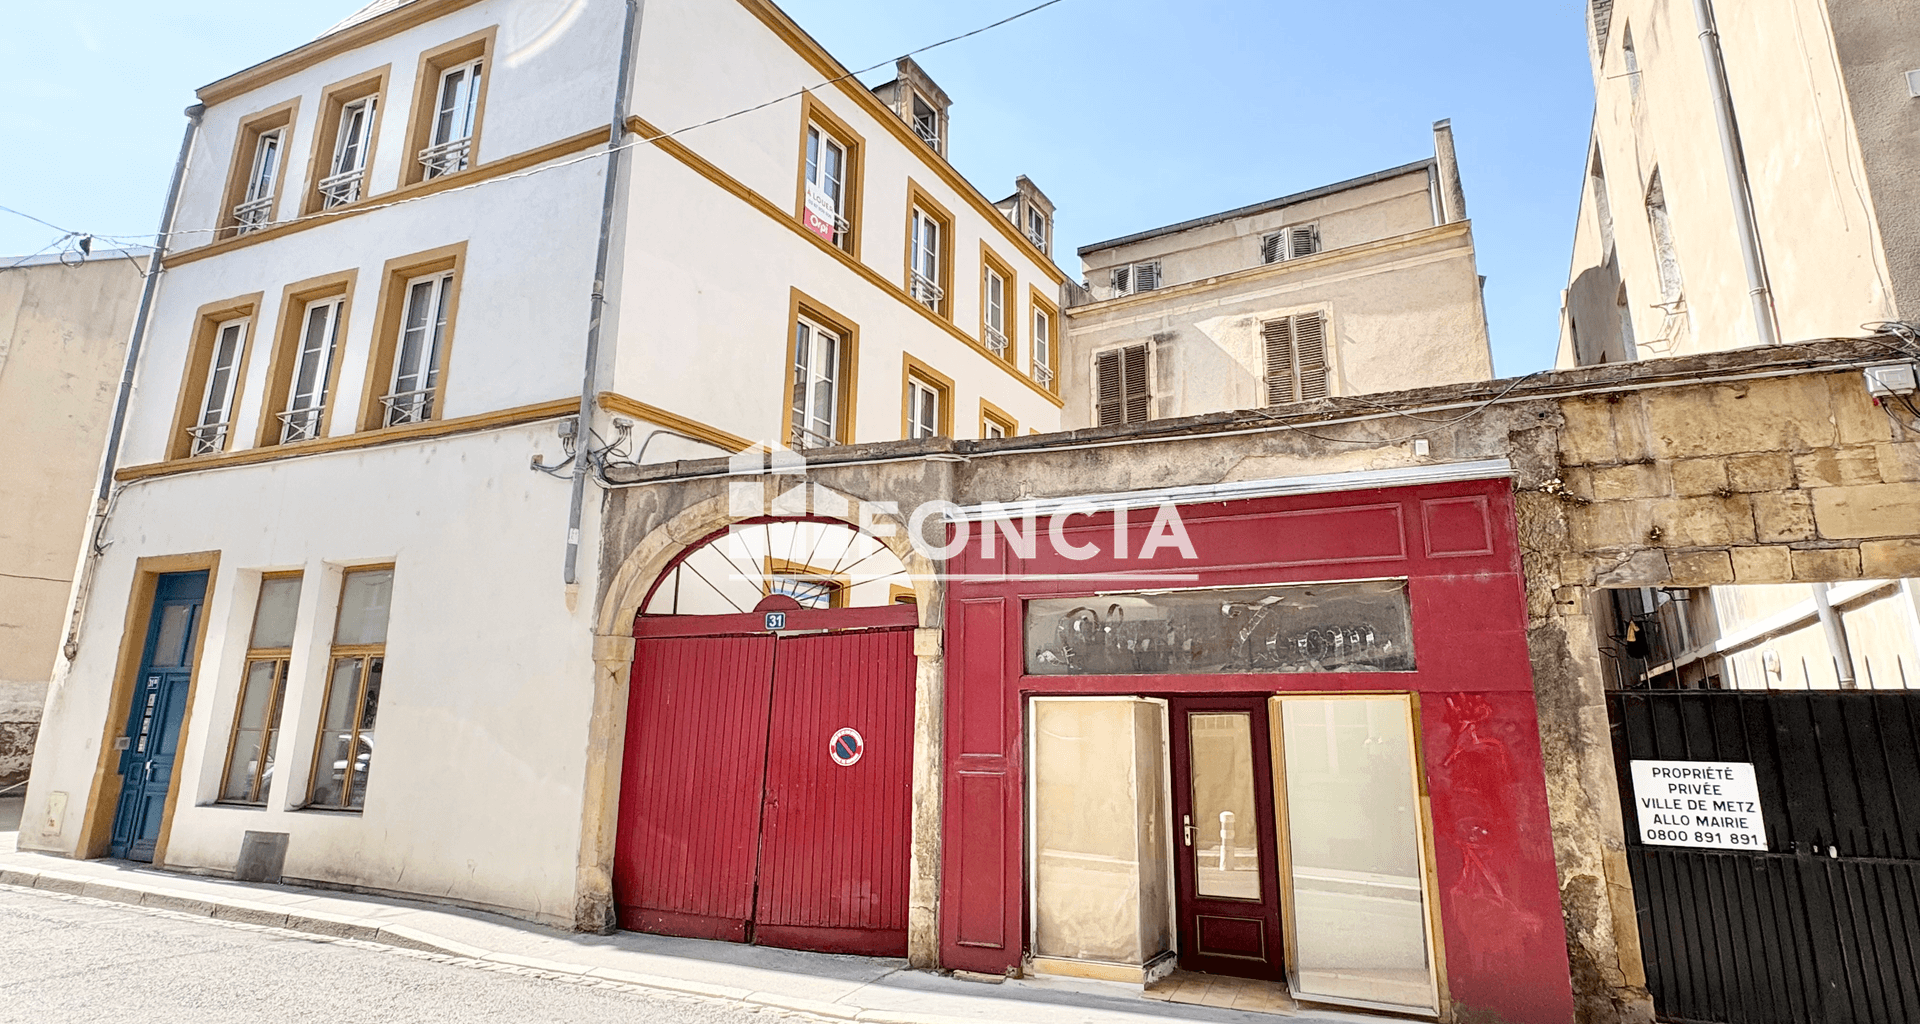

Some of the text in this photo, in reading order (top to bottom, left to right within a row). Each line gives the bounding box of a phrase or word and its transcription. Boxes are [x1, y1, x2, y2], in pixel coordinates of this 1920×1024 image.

[810, 214, 828, 234] Orpi
[769, 615, 782, 627] 31
[1652, 766, 1734, 780] PROPRIÉTÉ
[1668, 782, 1722, 796] PRIVÉE
[1641, 797, 1756, 813] VILLE DE METZ
[1653, 814, 1749, 829] ALLO MAIRIE
[1647, 829, 1758, 845] 0800 891 891
